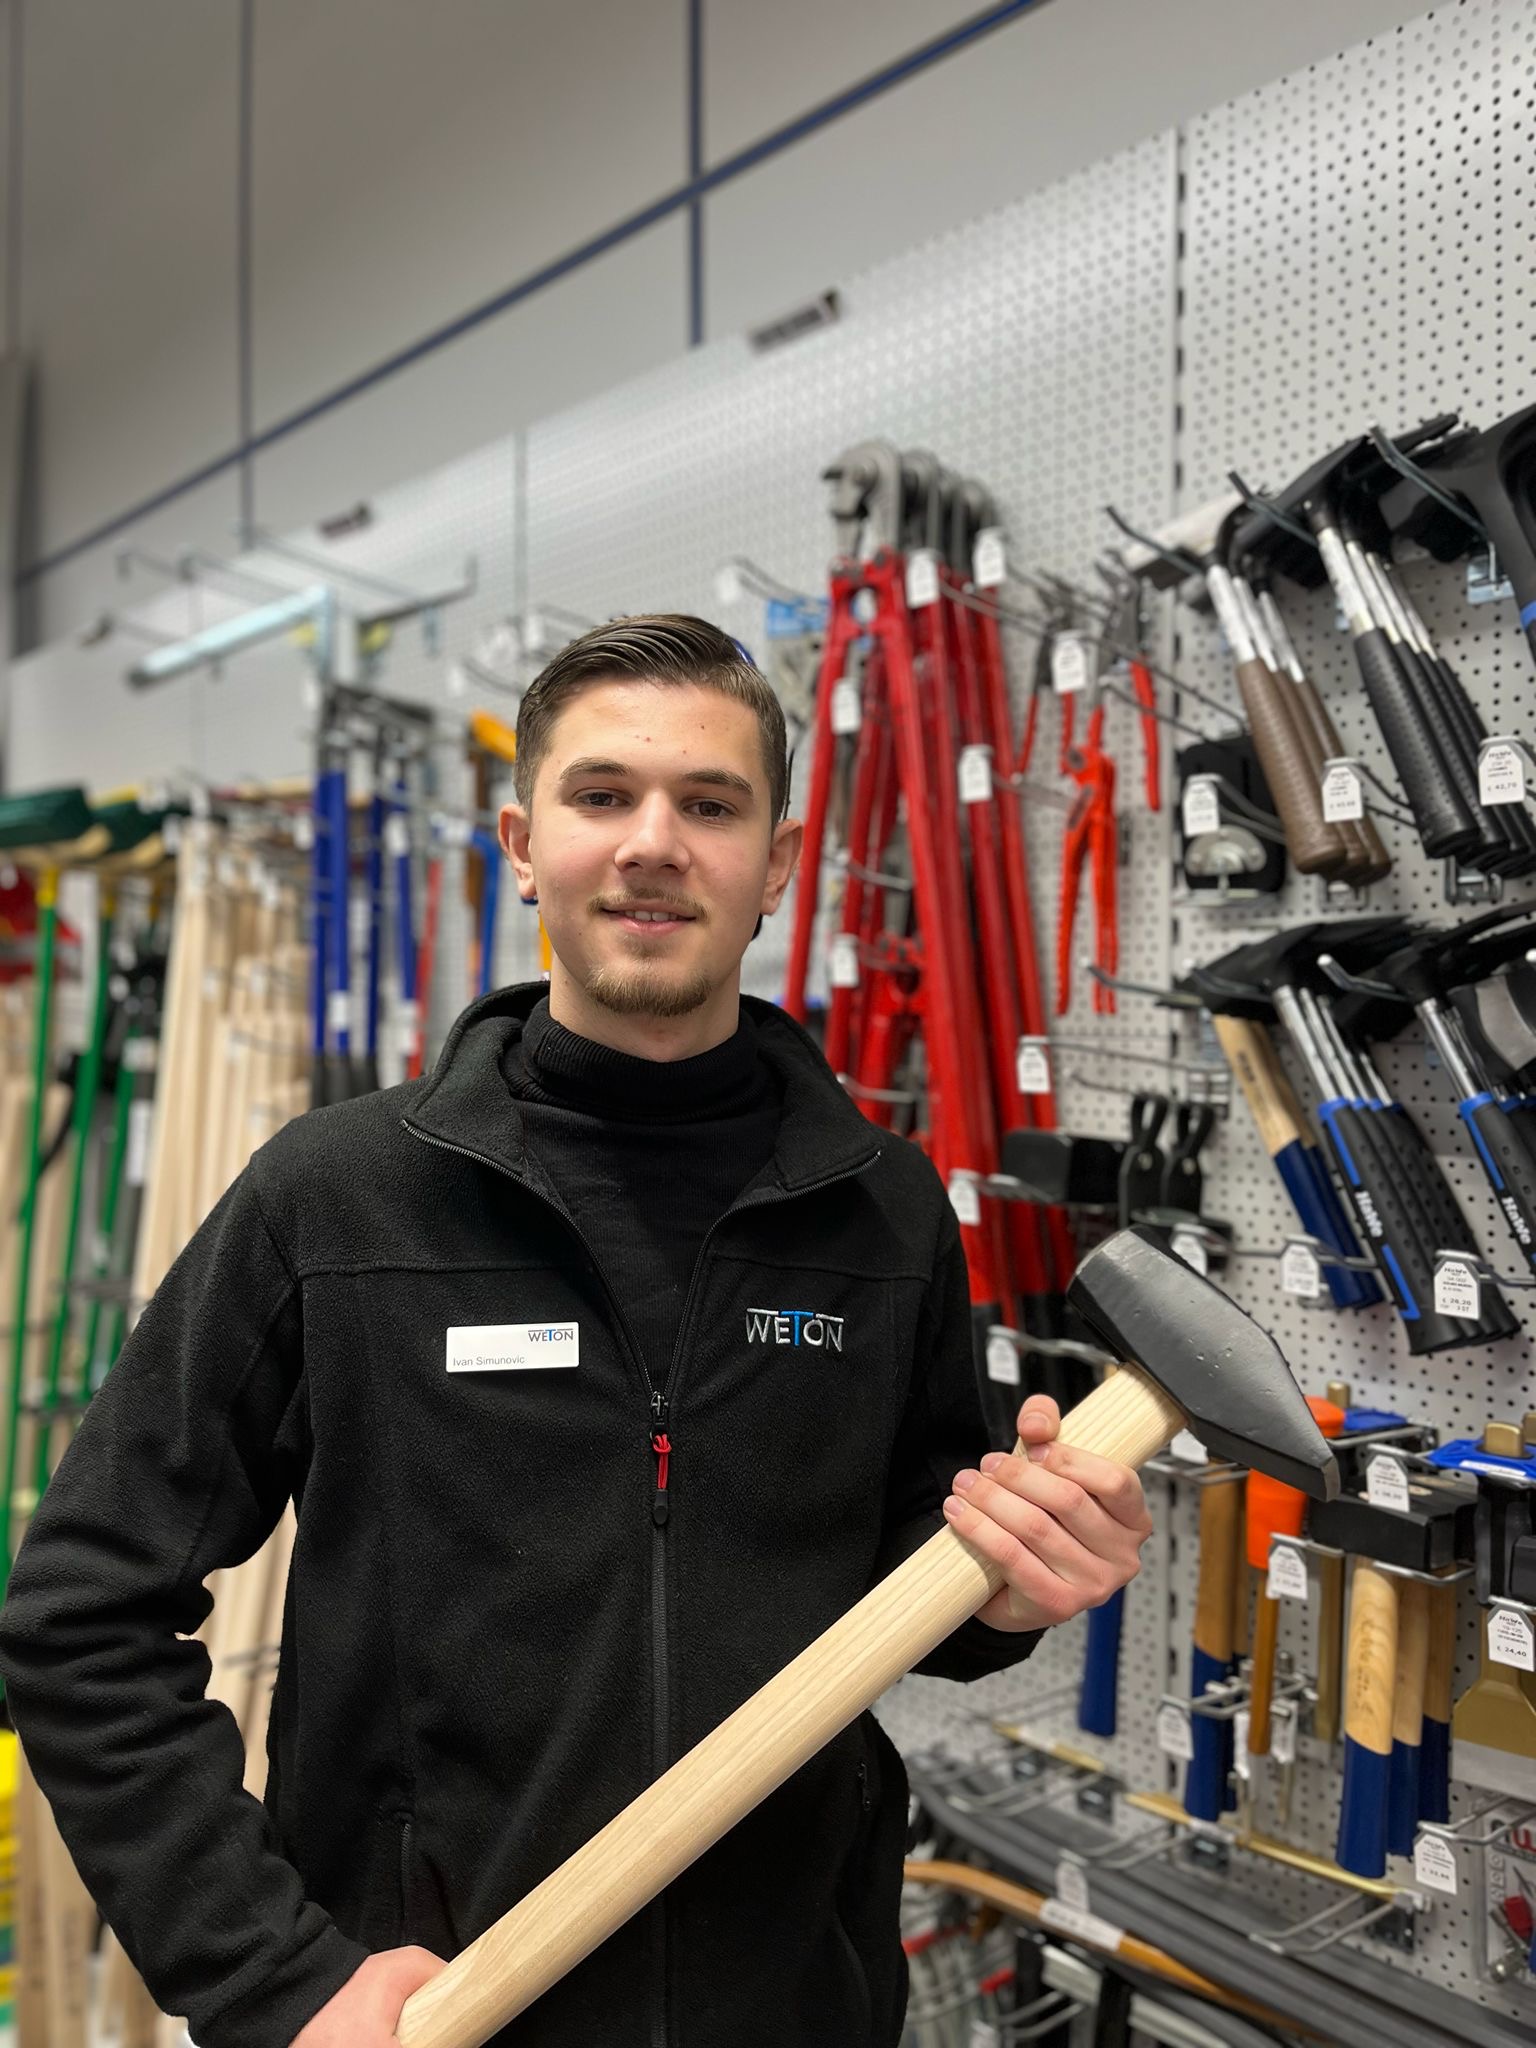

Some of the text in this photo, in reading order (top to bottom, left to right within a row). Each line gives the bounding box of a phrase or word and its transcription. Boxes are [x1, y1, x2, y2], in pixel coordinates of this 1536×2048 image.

[1501, 1196, 1531, 1244] HaWe
[527, 1328, 574, 1342] WETON
[746, 1307, 844, 1352] WETON
[453, 1357, 473, 1367] Ivan
